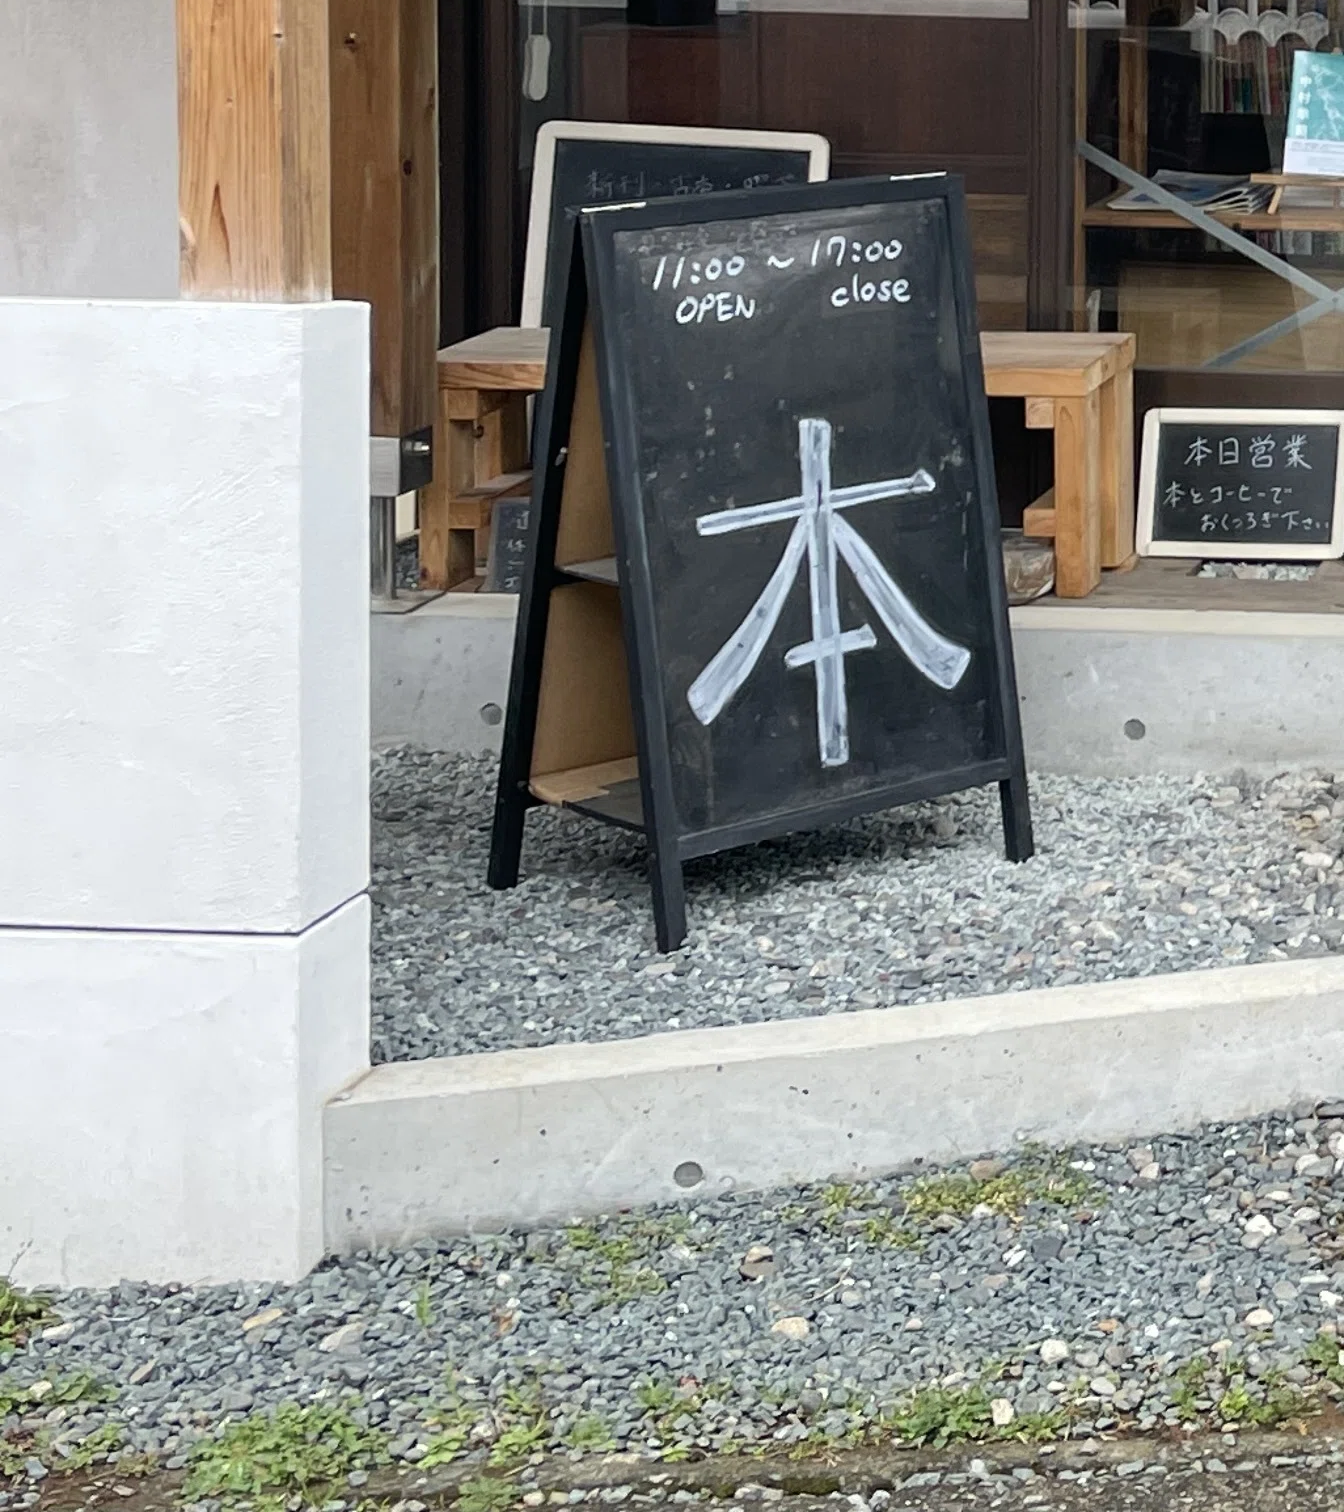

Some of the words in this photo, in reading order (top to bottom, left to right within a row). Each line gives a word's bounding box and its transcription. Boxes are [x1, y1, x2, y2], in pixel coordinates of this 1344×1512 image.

[674, 291, 757, 326] OPEN
[829, 273, 913, 309] close
[1183, 433, 1314, 470] 本日営業
[685, 416, 973, 769] 本
